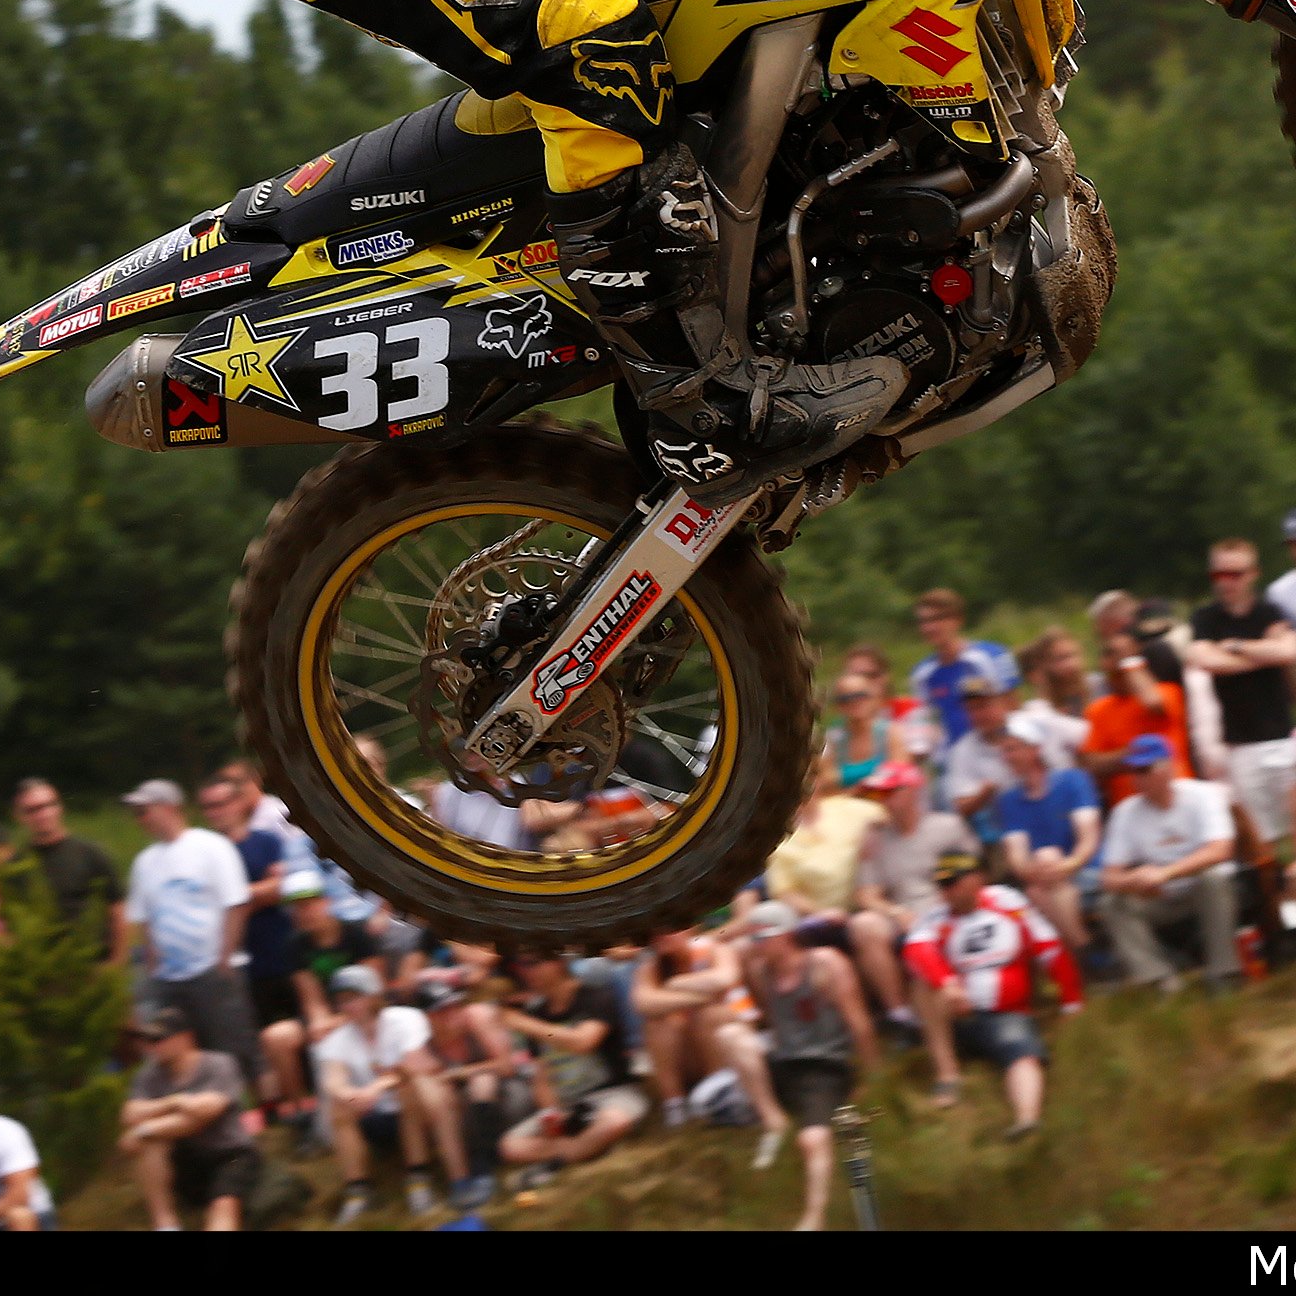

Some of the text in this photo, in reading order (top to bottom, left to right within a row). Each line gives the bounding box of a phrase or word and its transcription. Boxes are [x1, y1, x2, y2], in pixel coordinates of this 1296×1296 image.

[909, 82, 975, 101] Bischof
[350, 189, 427, 212] SUZUKI
[451, 197, 514, 225] HINSON
[338, 230, 406, 264] MENEKS
[567, 267, 651, 289] FOX
[109, 284, 176, 318] PIRELLI
[333, 302, 414, 328] LIEBER
[40, 307, 101, 344] MOTUL
[527, 344, 578, 369] MX2
[313, 316, 451, 432] 33
[533, 576, 652, 711] RENTHAL
